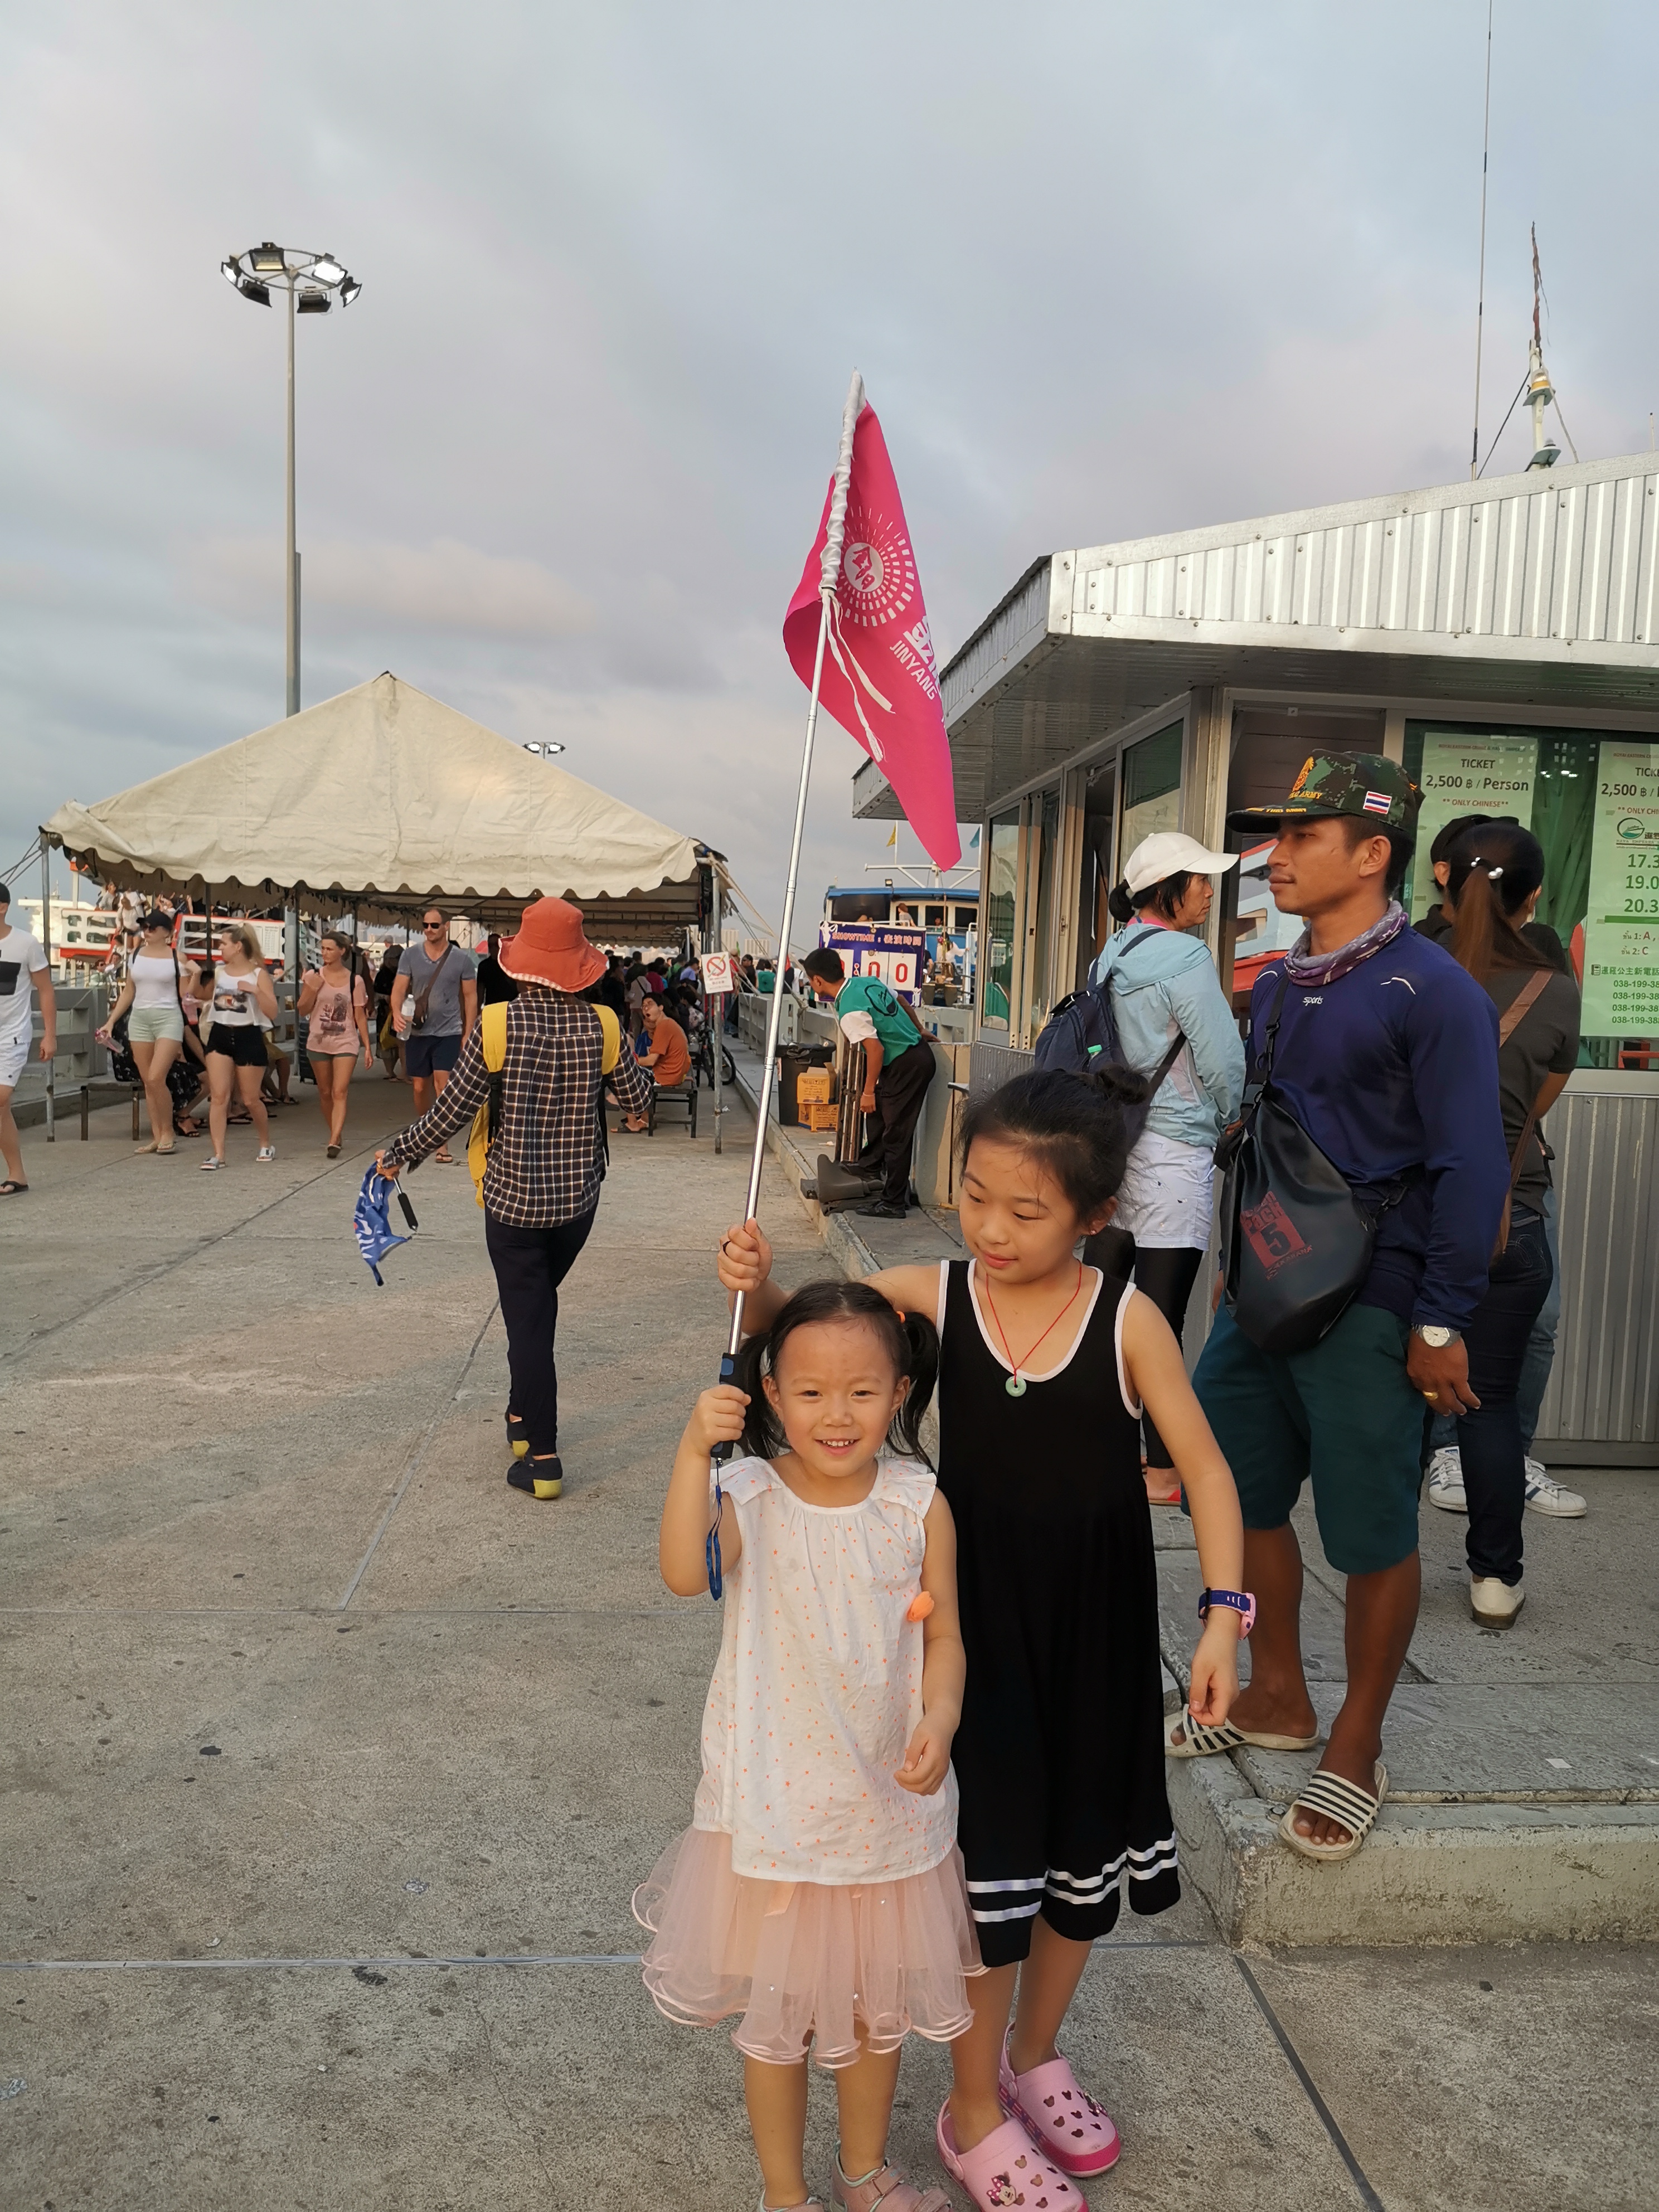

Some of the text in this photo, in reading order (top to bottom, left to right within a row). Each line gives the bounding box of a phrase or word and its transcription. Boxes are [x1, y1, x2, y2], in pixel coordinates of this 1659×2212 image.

[890, 640, 938, 700] JINYANG
[1461, 759, 1496, 769] TICKET
[1425, 775, 1462, 789] 2,500
[1483, 778, 1529, 791] Person
[1601, 783, 1637, 797] 2,500
[1626, 875, 1659, 889] 19.0
[1624, 898, 1658, 913] 20.3
[832, 932, 875, 942] SHOWTIME
[1642, 946, 1649, 955] C
[1260, 1222, 1291, 1257] 5
